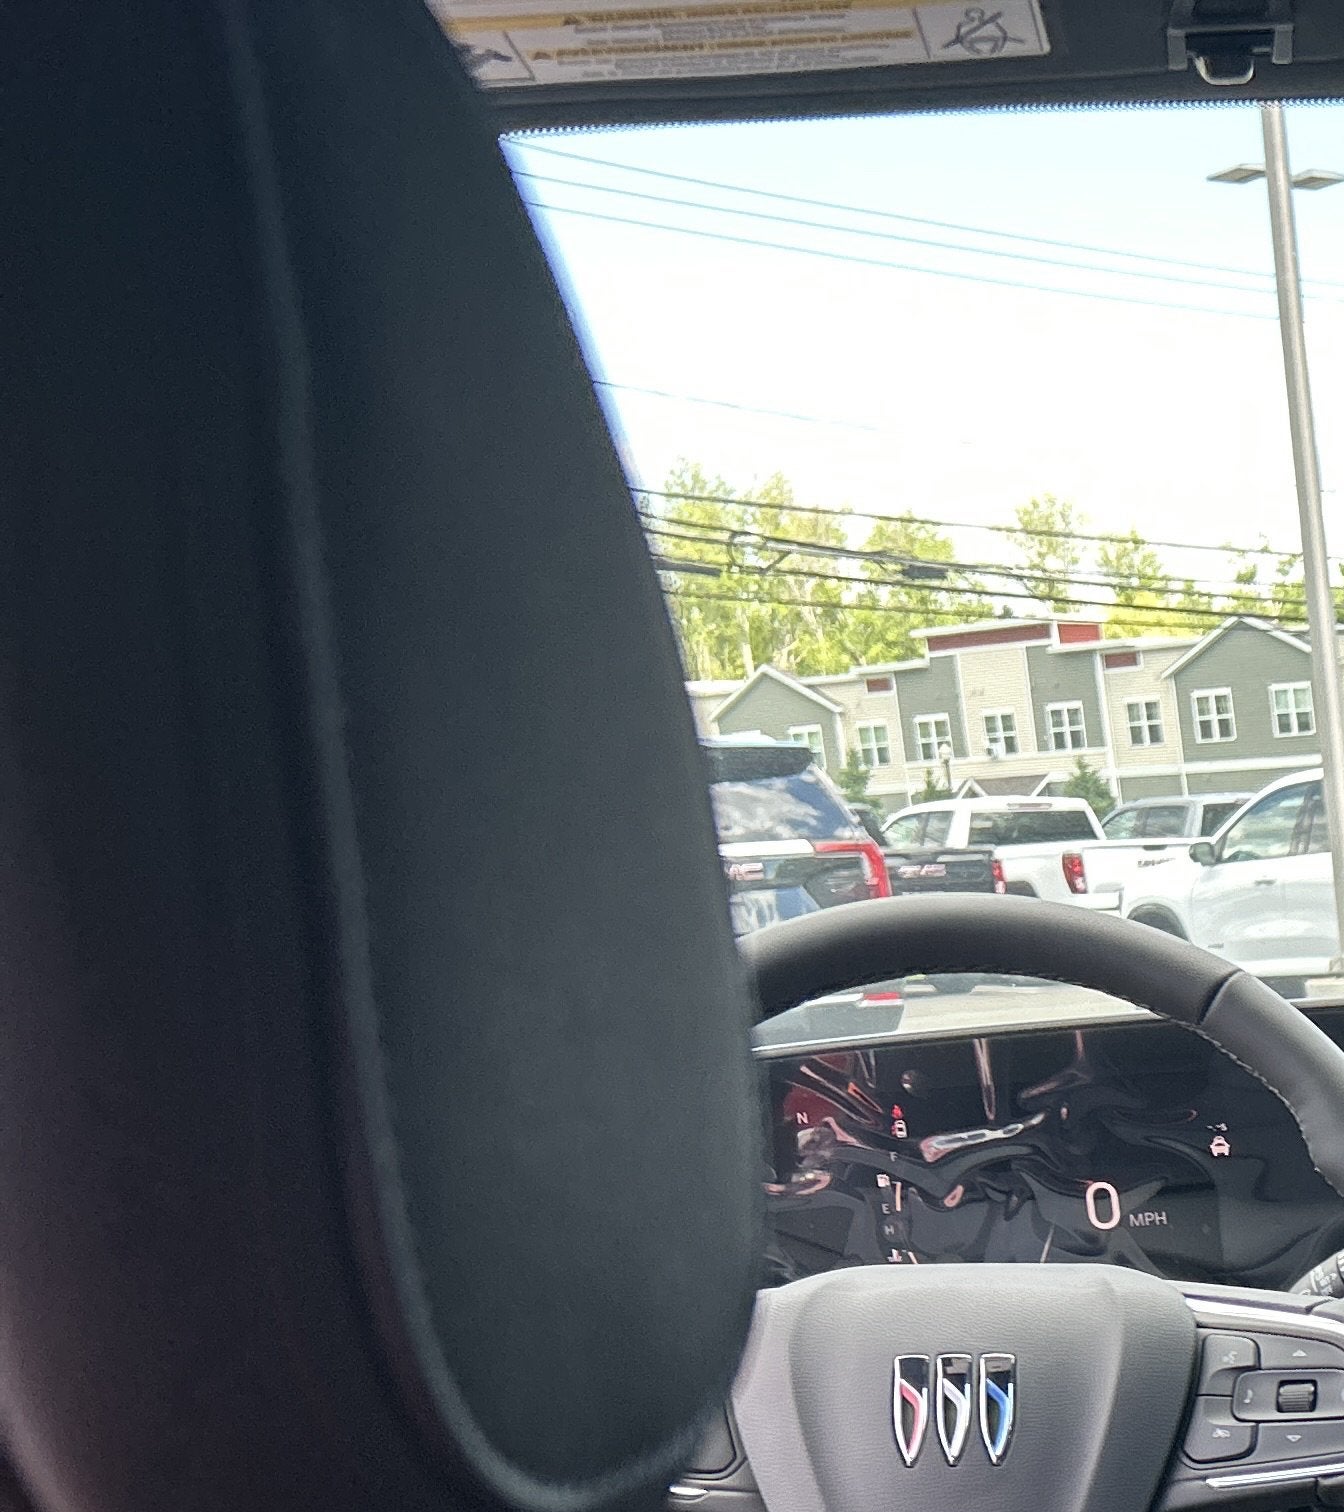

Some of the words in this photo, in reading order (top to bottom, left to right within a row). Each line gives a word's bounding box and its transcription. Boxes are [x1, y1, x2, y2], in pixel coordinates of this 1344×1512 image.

[796, 1112, 809, 1124] N
[1086, 1181, 1120, 1230] 0
[1129, 1211, 1168, 1227] MPH
